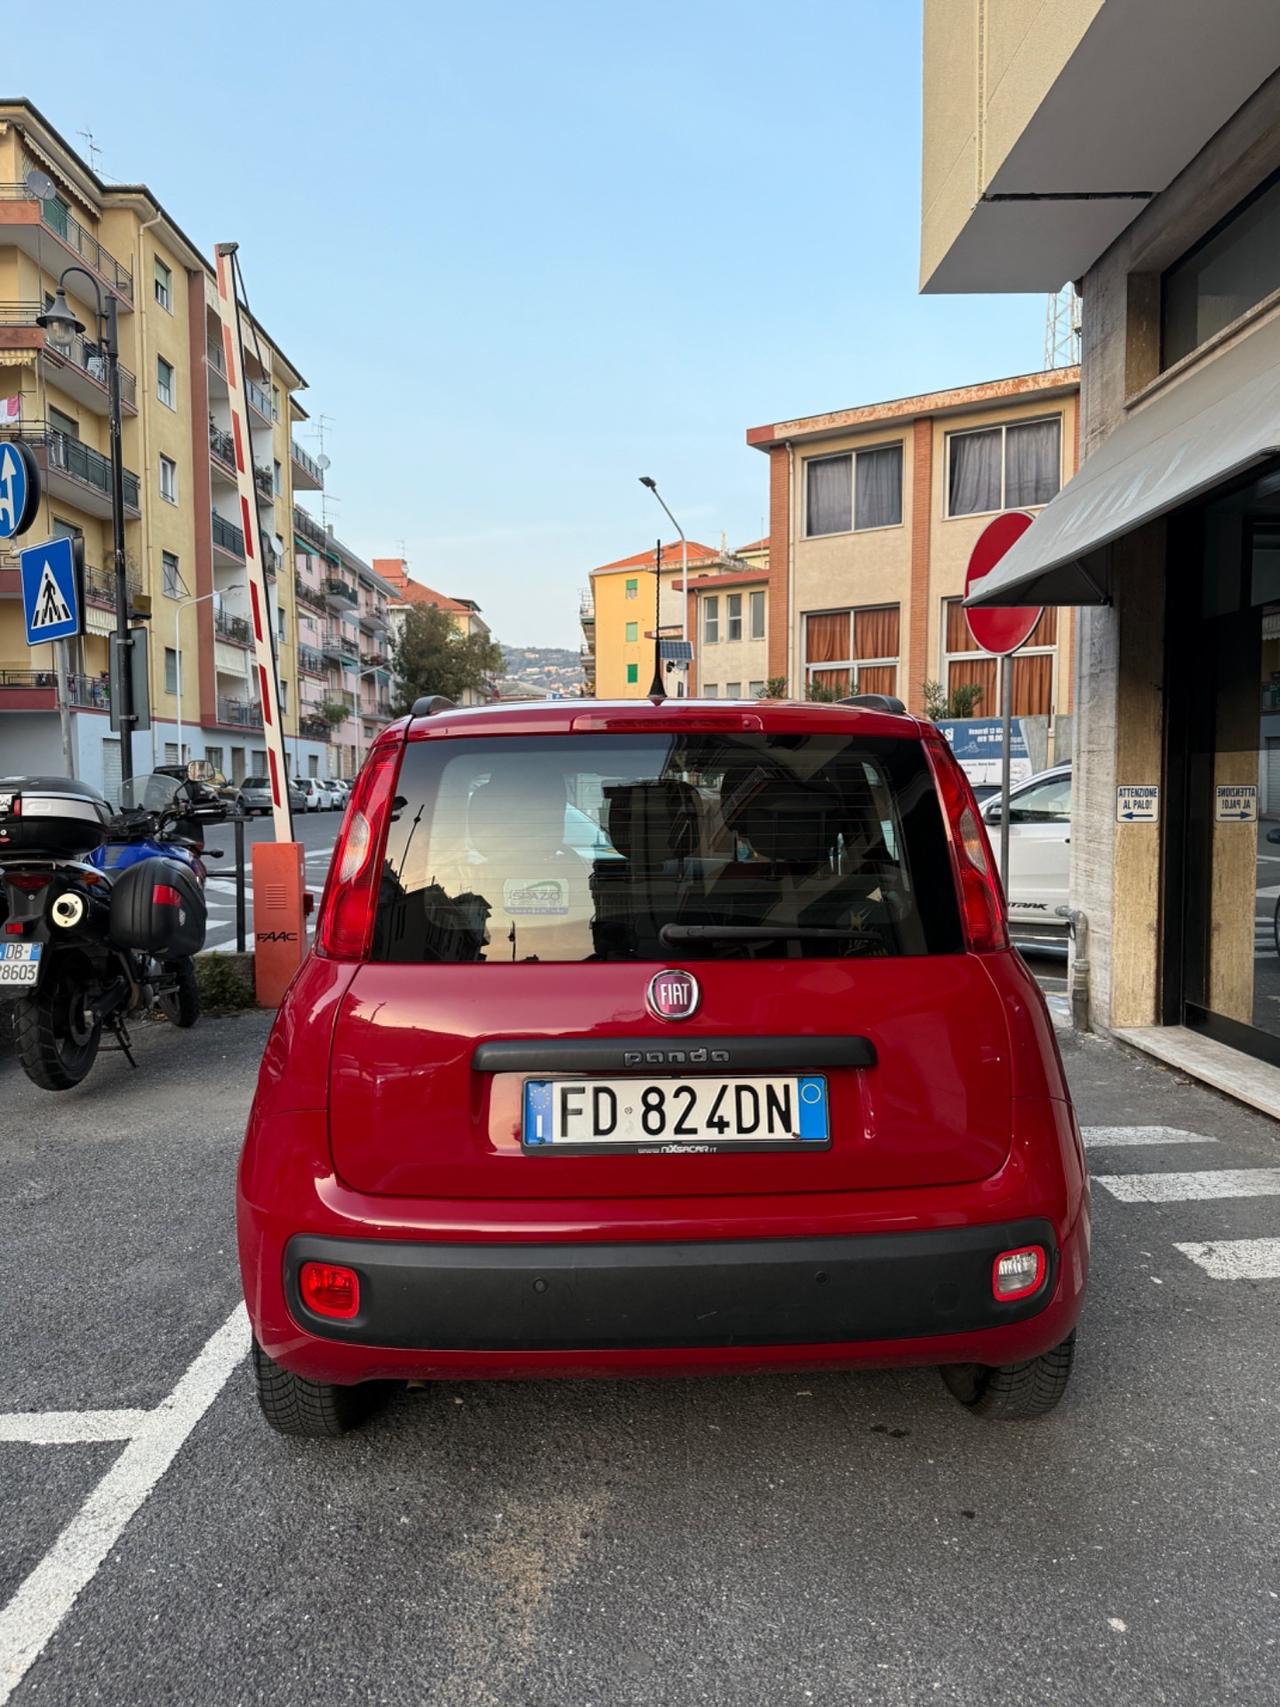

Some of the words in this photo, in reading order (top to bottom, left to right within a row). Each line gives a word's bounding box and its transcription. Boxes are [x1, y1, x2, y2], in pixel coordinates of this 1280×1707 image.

[1119, 787, 1157, 798] ATTENZIONE
[1123, 799, 1131, 810] AL
[1133, 799, 1152, 810] PALO!
[256, 931, 298, 943] FAAC
[6, 944, 23, 960] DB
[0, 964, 36, 980] 8603
[660, 983, 690, 1006] FIAT
[624, 1048, 729, 1067] panda
[560, 1086, 618, 1137] FD
[640, 1084, 793, 1136] 824DN
